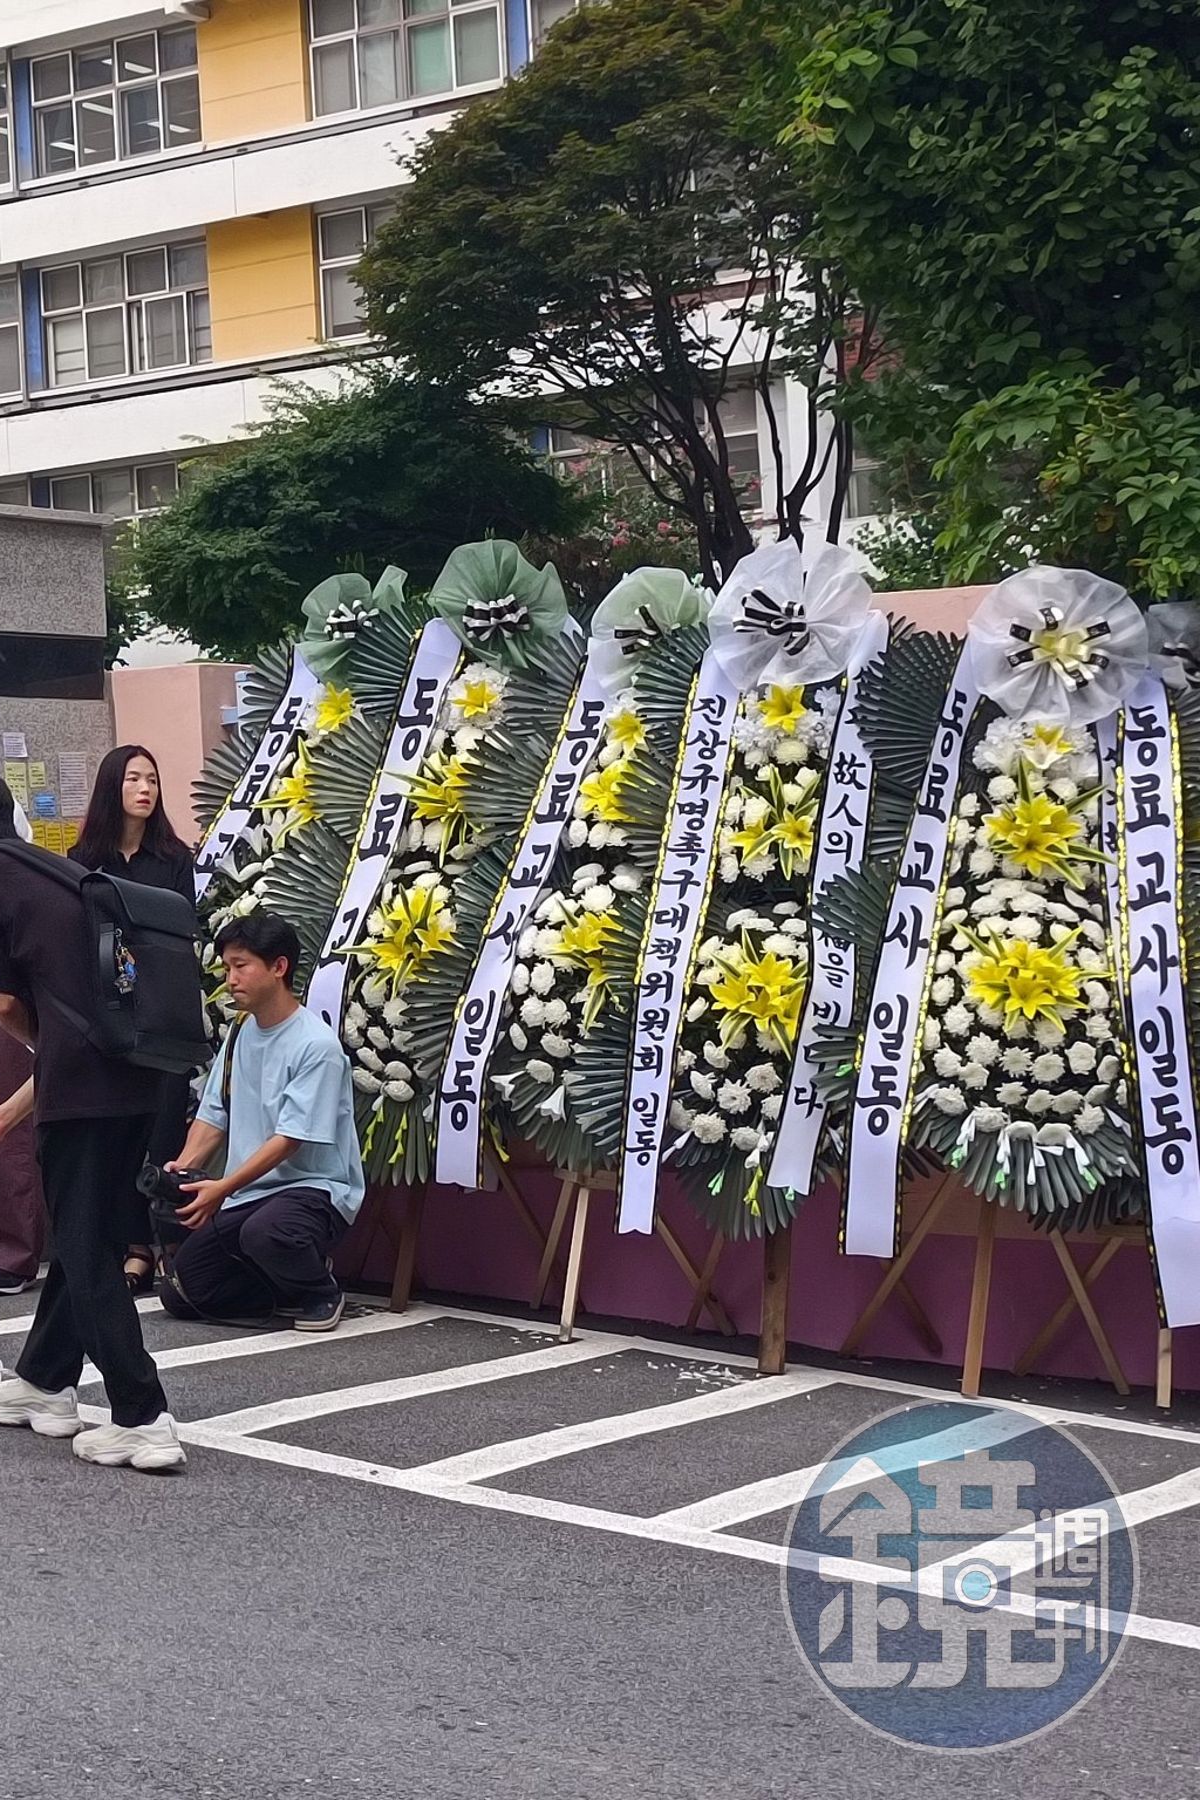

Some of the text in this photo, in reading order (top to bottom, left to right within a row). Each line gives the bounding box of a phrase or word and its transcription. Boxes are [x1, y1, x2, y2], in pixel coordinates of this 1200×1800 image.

[194, 697, 302, 900] 동료교
[319, 678, 437, 1028] 동료교
[624, 694, 728, 1167] 진상규명촉구대책위원회 일동
[823, 751, 867, 866] 故人의
[856, 691, 967, 1138] 동료교사 일동
[1124, 705, 1192, 1175] 동료교사 일동
[441, 989, 496, 1131] 일동
